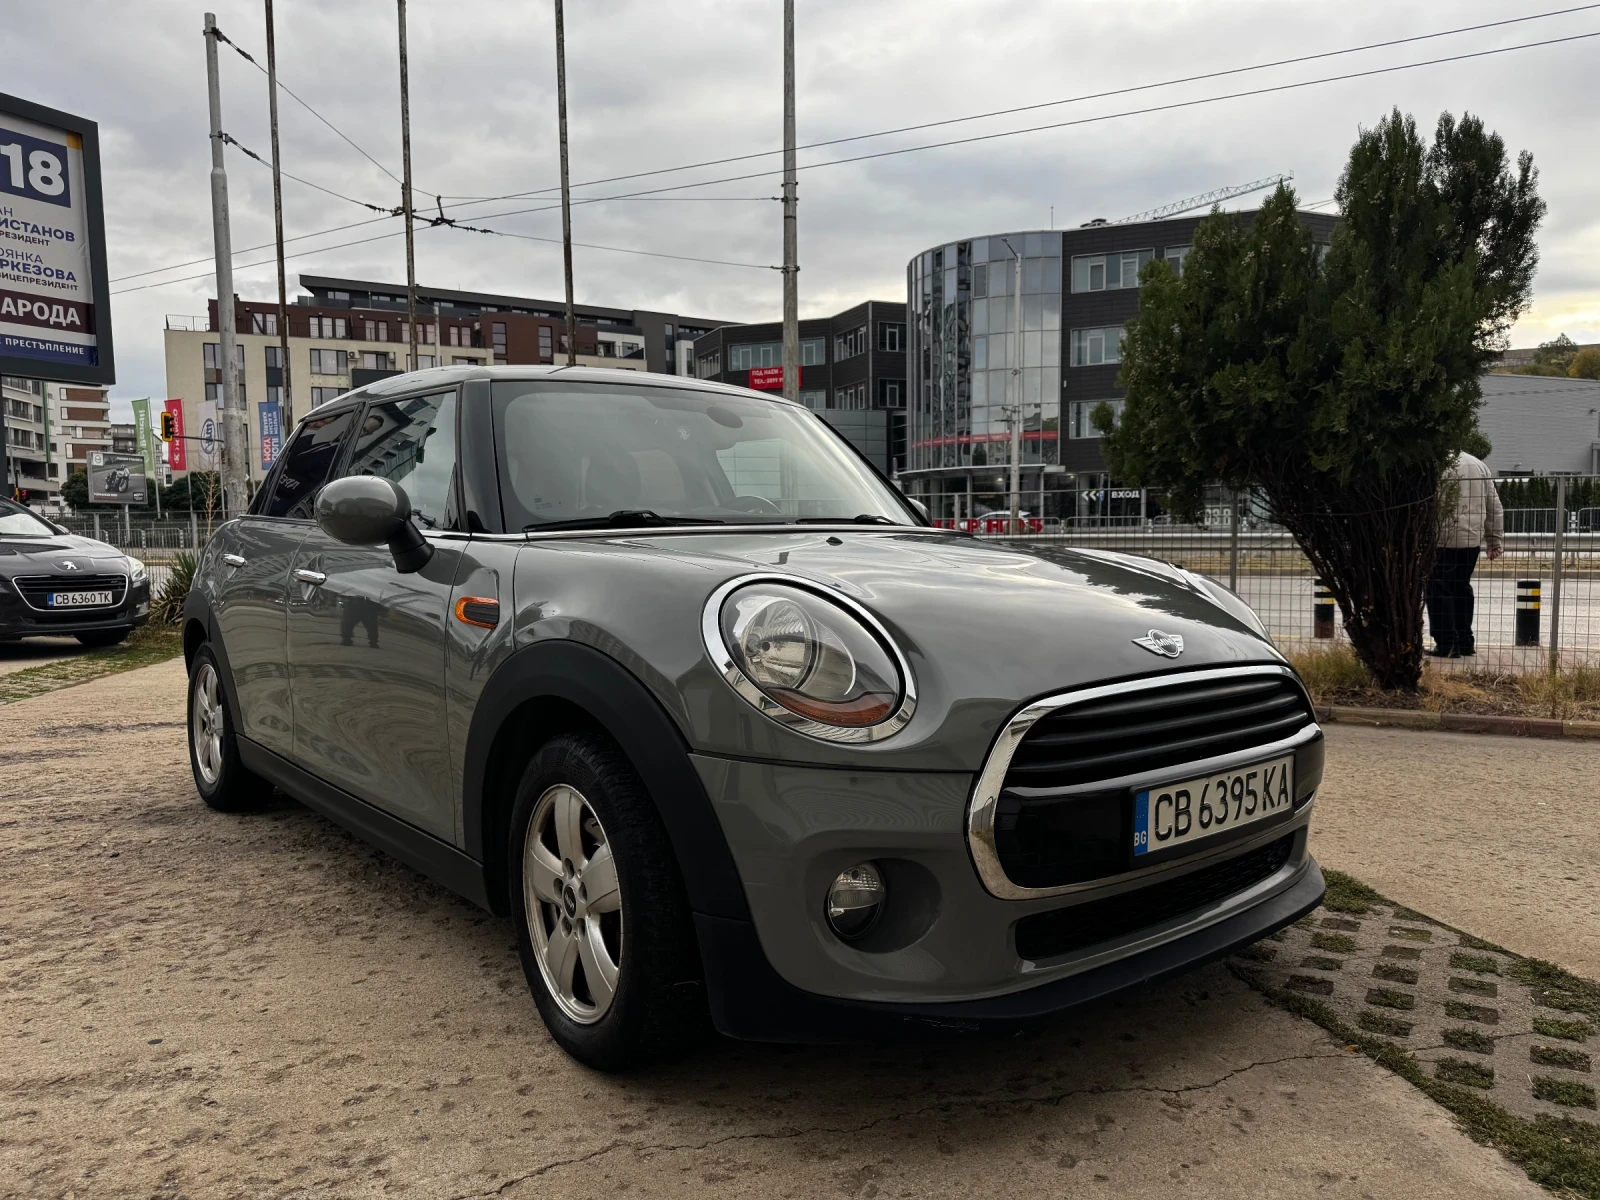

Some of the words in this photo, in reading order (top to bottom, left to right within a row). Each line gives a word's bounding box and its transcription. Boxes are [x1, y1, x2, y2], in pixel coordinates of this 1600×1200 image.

[0, 142, 65, 196] 18
[0, 272, 79, 291] ИЦЕПРЕЗИДЕНТ
[1, 297, 81, 326] АРОДА
[5, 337, 84, 355] ПРЕСТЪПЛЕНИЕ
[1111, 490, 1140, 499] ВХОД
[55, 594, 69, 604] CB
[72, 593, 96, 604] 6360
[98, 592, 110, 603] TK
[1154, 789, 1192, 842] CB
[1199, 771, 1258, 829] 6395
[1262, 763, 1289, 811] KA
[1134, 831, 1147, 846] BG
